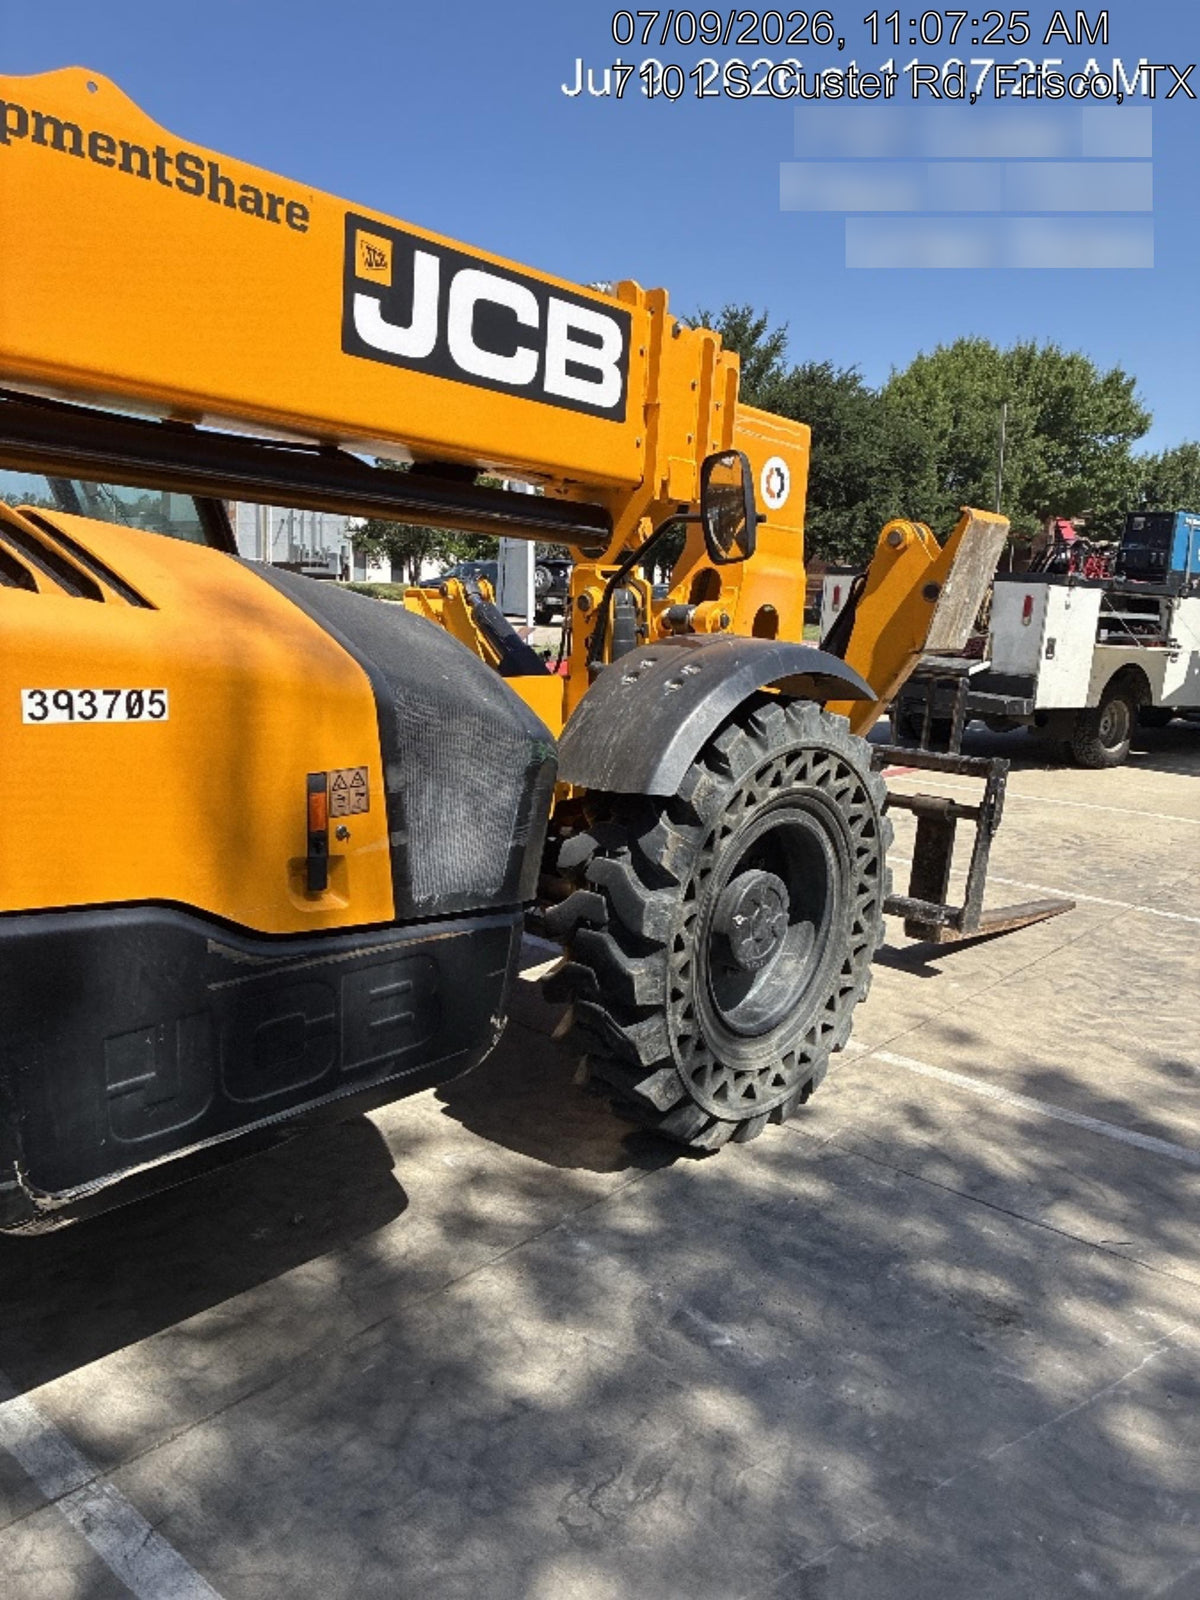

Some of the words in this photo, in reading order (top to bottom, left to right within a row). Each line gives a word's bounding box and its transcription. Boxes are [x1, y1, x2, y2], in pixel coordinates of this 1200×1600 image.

[0, 99, 310, 233] pmentShare
[353, 249, 624, 409] JCB
[27, 689, 166, 721] 393705
